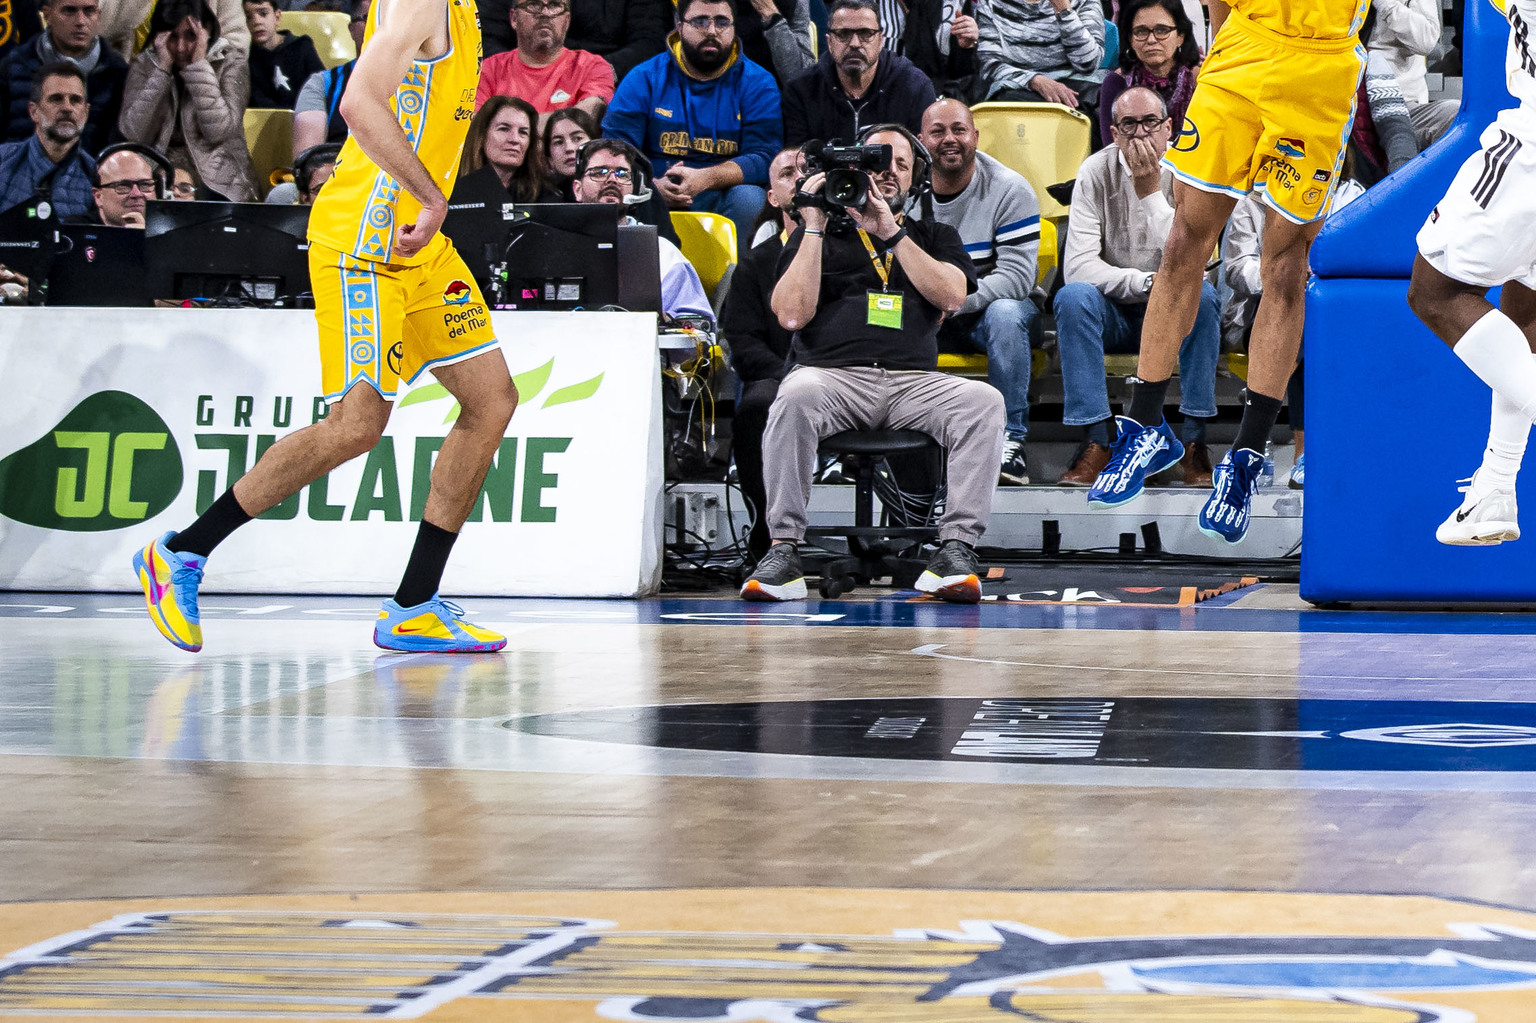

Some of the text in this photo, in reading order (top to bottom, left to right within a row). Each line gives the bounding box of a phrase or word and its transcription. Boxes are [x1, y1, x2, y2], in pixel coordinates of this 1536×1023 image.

[443, 305, 484, 327] Poema
[448, 317, 488, 339] del Mar
[54, 431, 168, 519] JC
